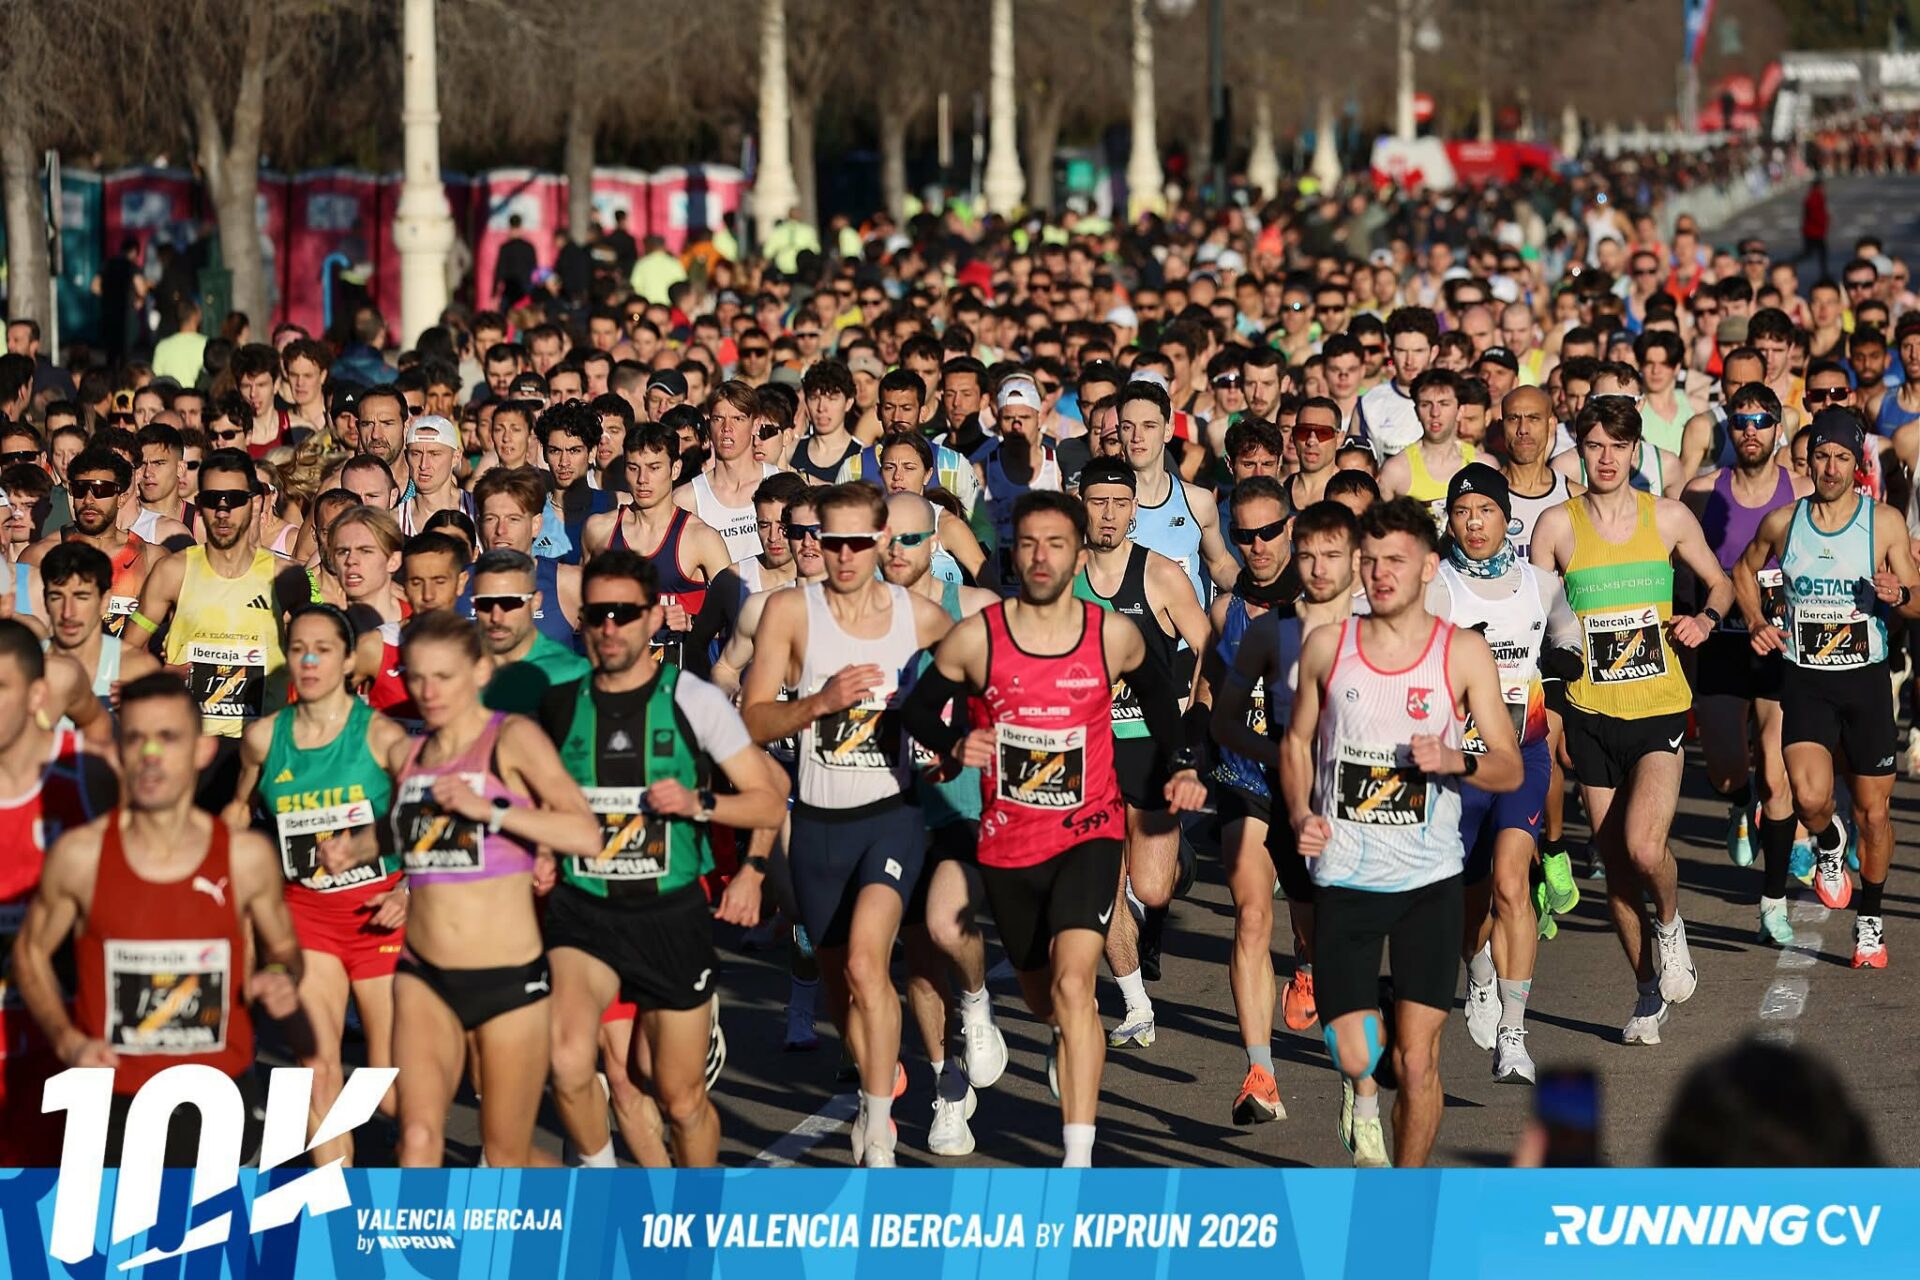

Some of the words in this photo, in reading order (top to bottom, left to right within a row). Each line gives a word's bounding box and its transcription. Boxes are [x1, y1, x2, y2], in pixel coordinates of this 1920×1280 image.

[1589, 615, 1635, 628] Ibercaja
[1800, 609, 1843, 620] Ibercaja
[194, 647, 239, 661] Ibercaja
[1806, 653, 1864, 665] KIPRUN
[1599, 662, 1660, 681] KIPRUN
[204, 676, 247, 697] 1787
[1003, 729, 1056, 747] Ibercaja
[1008, 785, 1078, 806] KIPRUN
[285, 812, 338, 829] Ibercaja
[1345, 806, 1418, 824] KIPRUN
